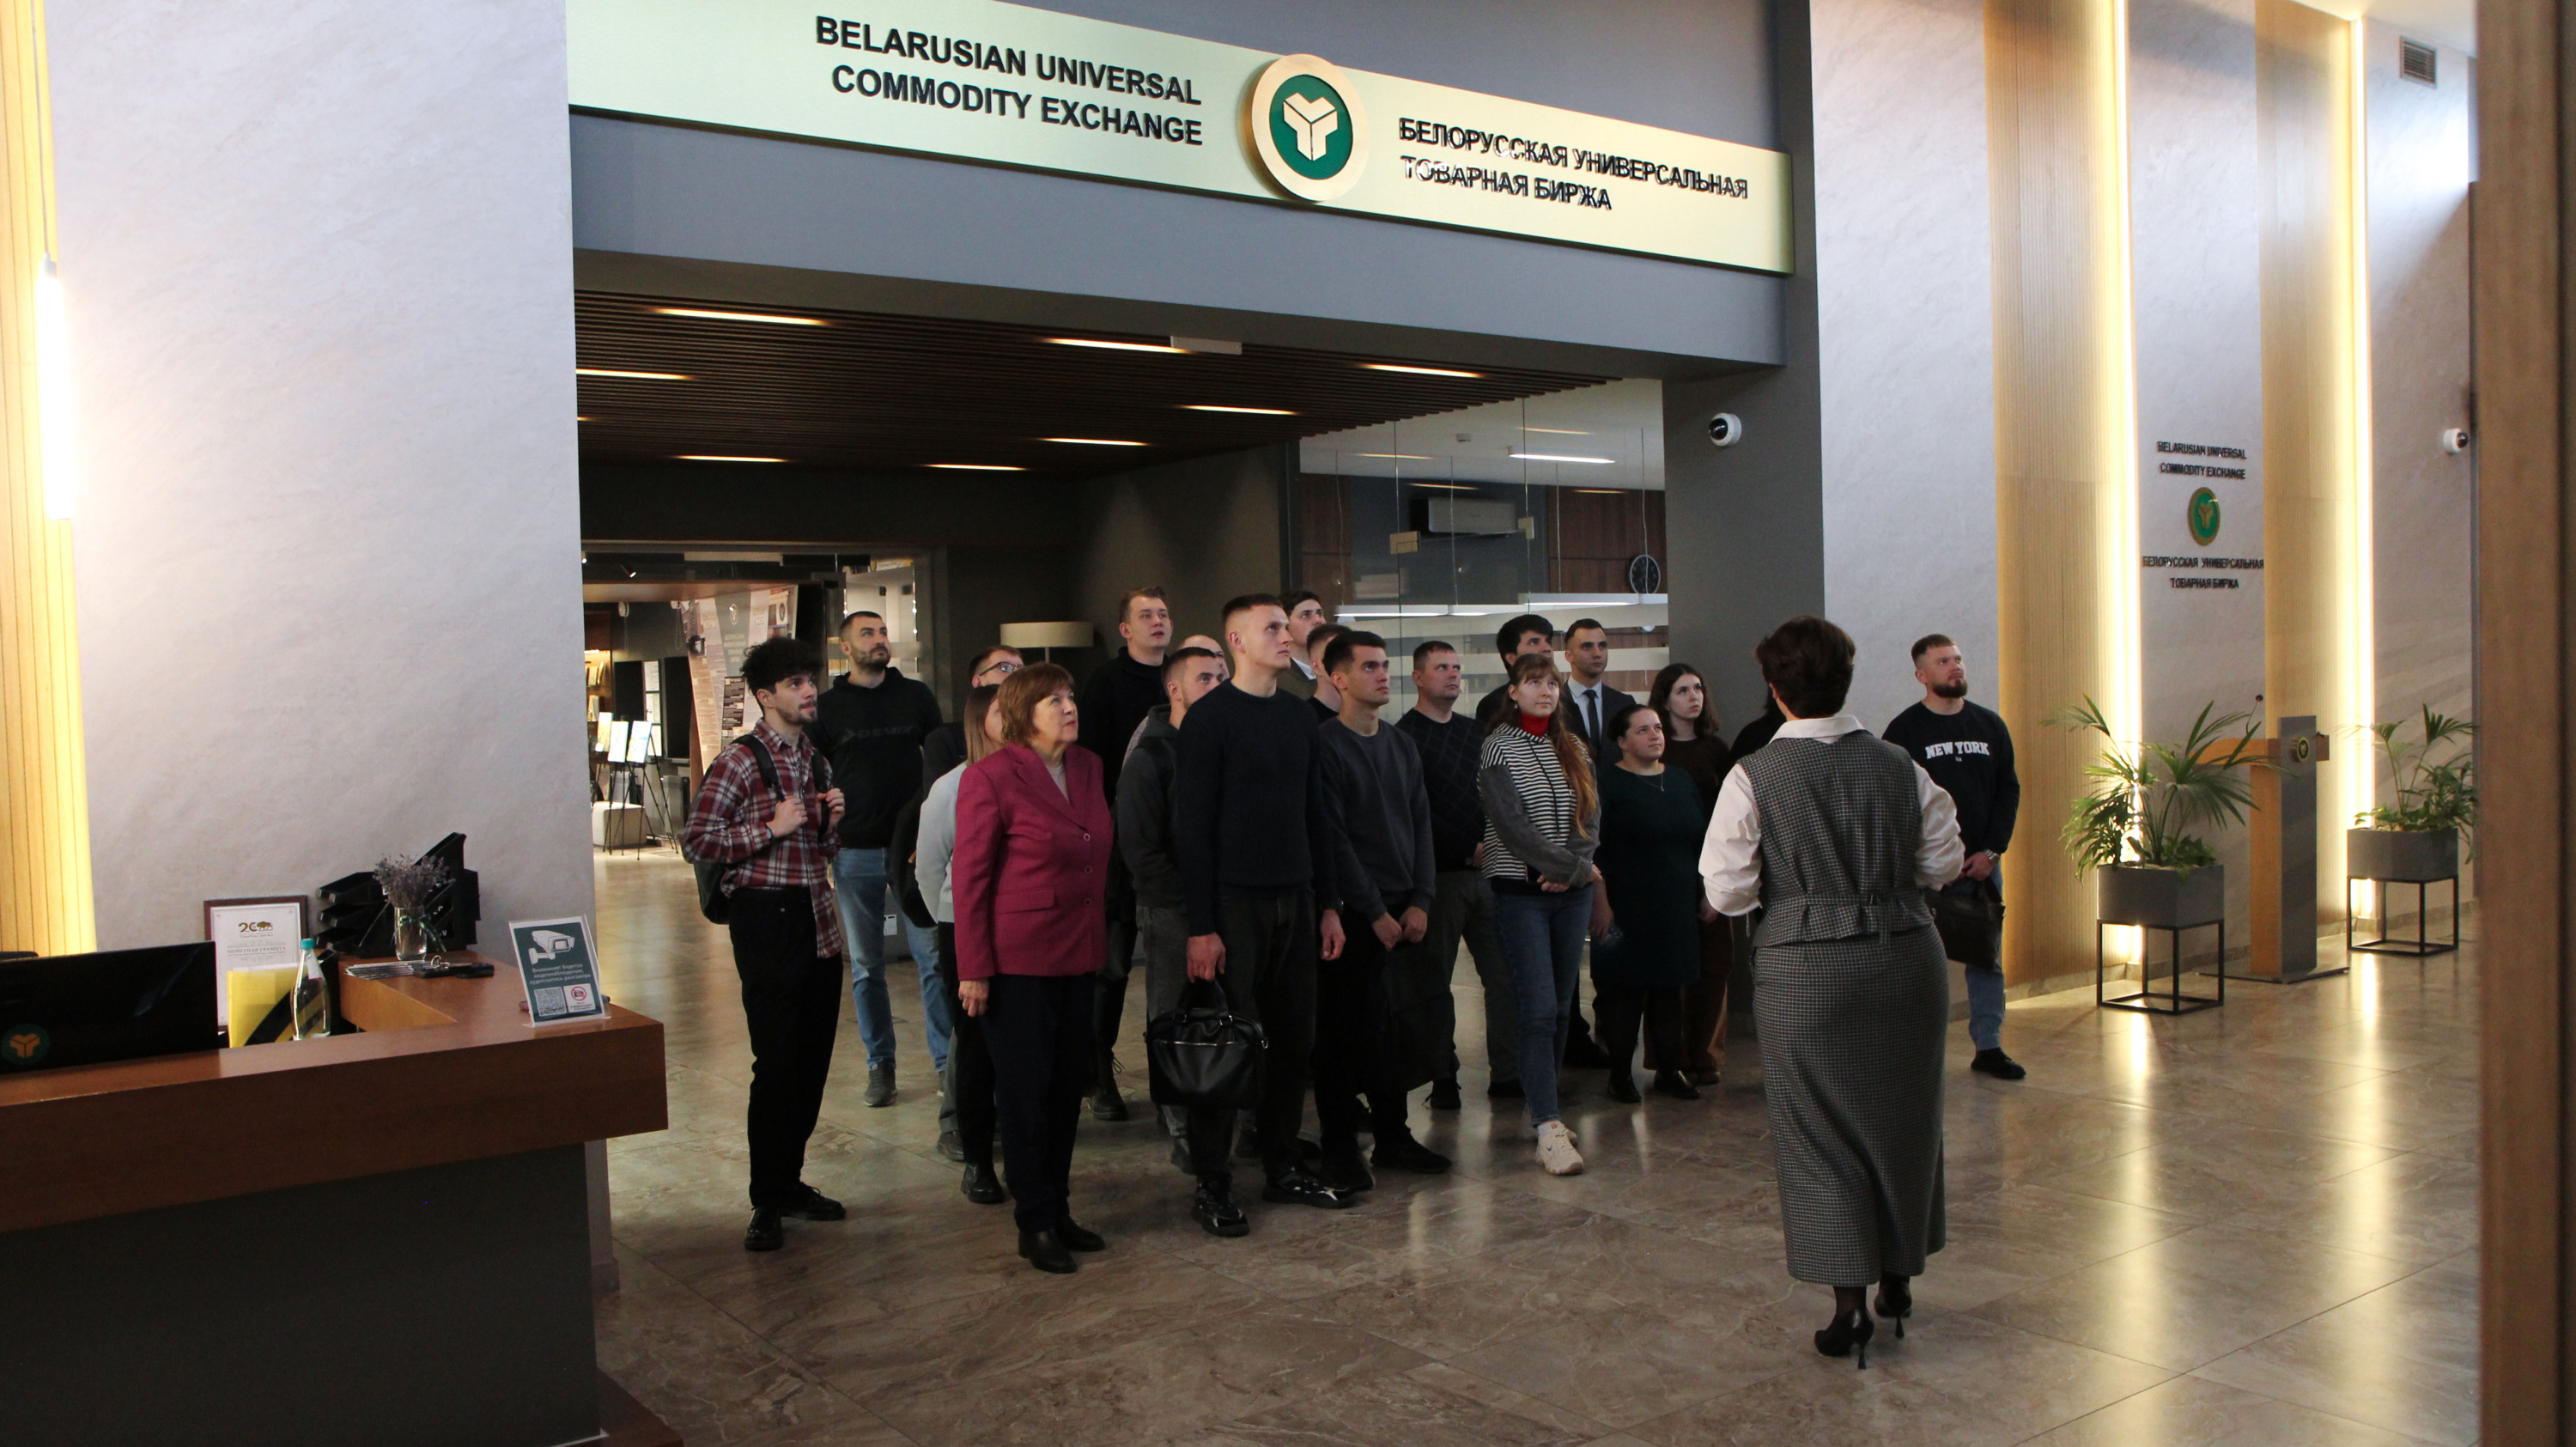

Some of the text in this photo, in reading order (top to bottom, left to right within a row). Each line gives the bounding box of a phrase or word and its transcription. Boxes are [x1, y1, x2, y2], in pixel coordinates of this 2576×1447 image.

[816, 15, 1201, 106] BELARUSIAN UNIVERSAL
[832, 64, 1202, 145] COMMODITY EXCHANGE
[1399, 118, 1748, 199] БЕЛОРУССКАЯ УНИВЕРСАЛЬНАЯ
[1400, 155, 1613, 210] ТОВАРНАЯ БИРЖА
[2157, 441, 2247, 459] BELARUSIAN UNIVERSAL
[2160, 463, 2246, 479] COMMODITY EXCHANGE
[2142, 556, 2264, 568] БЕЛОРУССКАЯ УНИВЕРСАЛЬНАЯ
[2170, 577, 2239, 589] ТОВАРНАЯ БИРЖА
[1925, 742, 1953, 759] NEW
[1954, 741, 1990, 756] YORK
